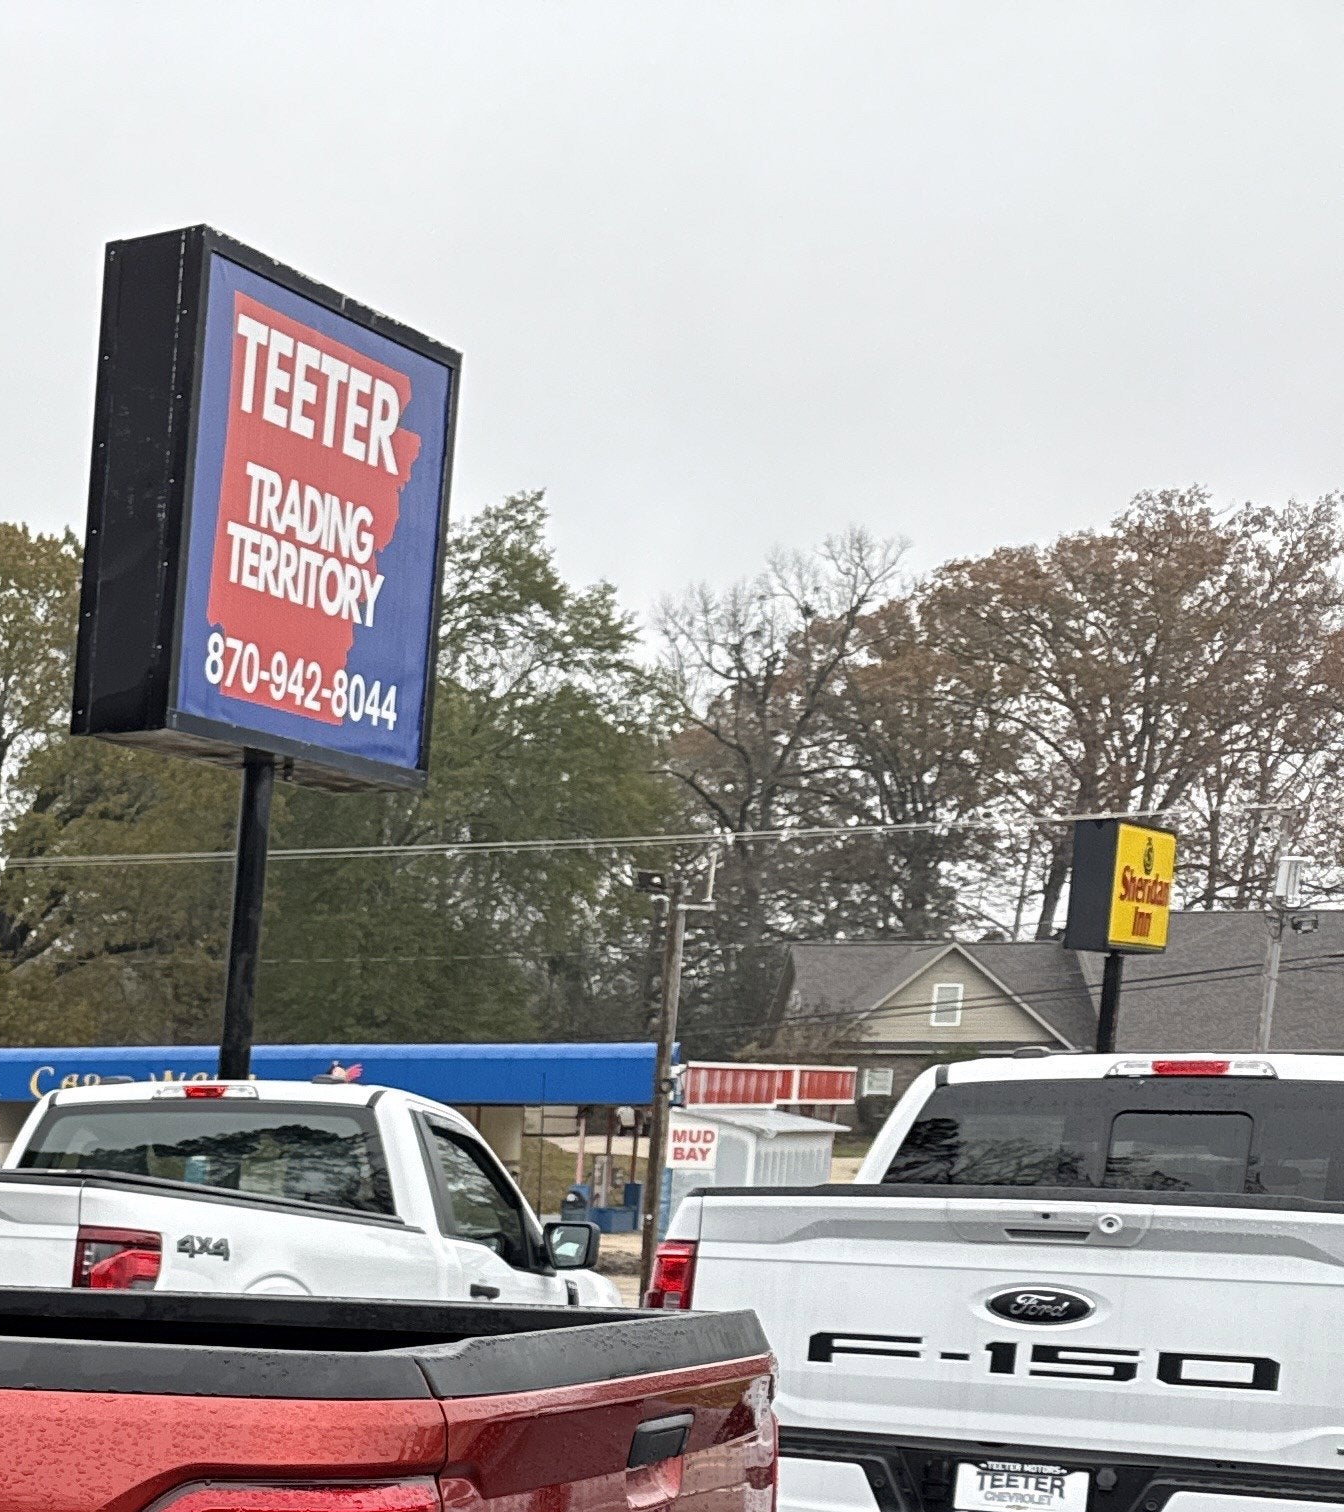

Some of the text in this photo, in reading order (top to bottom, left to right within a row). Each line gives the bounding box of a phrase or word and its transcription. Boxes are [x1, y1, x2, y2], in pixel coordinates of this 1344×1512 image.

[237, 312, 400, 476] TEETER
[246, 460, 375, 565] TRADING
[226, 519, 386, 628] TERRITORY
[204, 631, 398, 731] 870-942-8044
[1118, 865, 1170, 907] Sheridan
[1131, 905, 1153, 938] Inn
[671, 1129, 716, 1144] MUD
[672, 1146, 712, 1161] BAY
[1009, 1293, 1070, 1318] Ford
[806, 1331, 1282, 1393] F-150
[976, 1470, 1066, 1500] TEETER
[983, 1490, 1052, 1506] CHEVROLET
